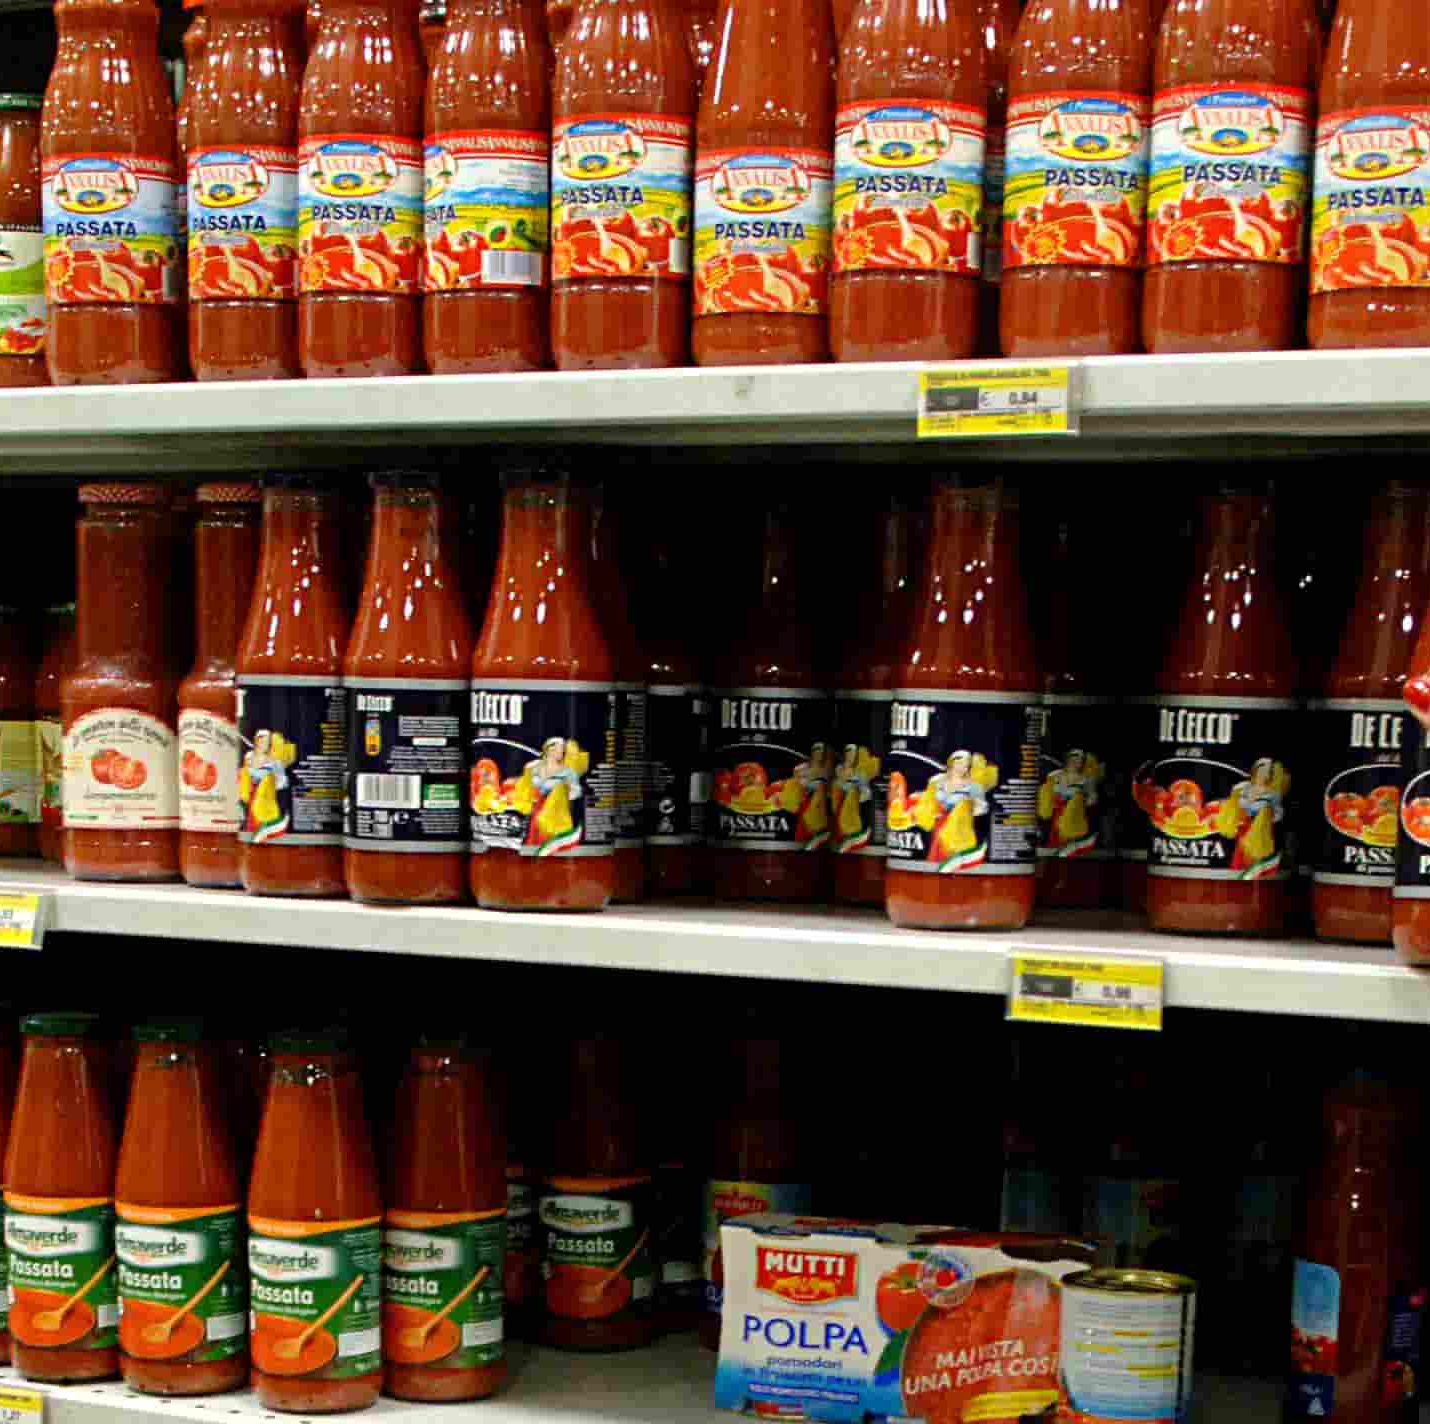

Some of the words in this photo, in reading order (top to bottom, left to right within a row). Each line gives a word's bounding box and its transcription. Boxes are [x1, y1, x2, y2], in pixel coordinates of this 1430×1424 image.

[1045, 168, 1139, 189] PASSATA
[1183, 163, 1281, 183] PASSATA
[854, 175, 948, 194] PASSATA
[1327, 187, 1425, 209] PASSATA
[311, 204, 397, 224] PASSATA
[56, 221, 138, 238] PASSATA
[714, 221, 806, 241] PASSATA
[1176, 711, 1232, 744] CECCO
[1151, 838, 1226, 859] PASSATA
[1344, 846, 1396, 868] PASS
[547, 1232, 615, 1254] Passata
[10, 1255, 74, 1279] Passata
[765, 1251, 846, 1277] MUTTI
[118, 1265, 183, 1291] Passata
[386, 1275, 439, 1297] assata
[742, 1313, 869, 1354] POLPA
[904, 1373, 951, 1395] UNA
